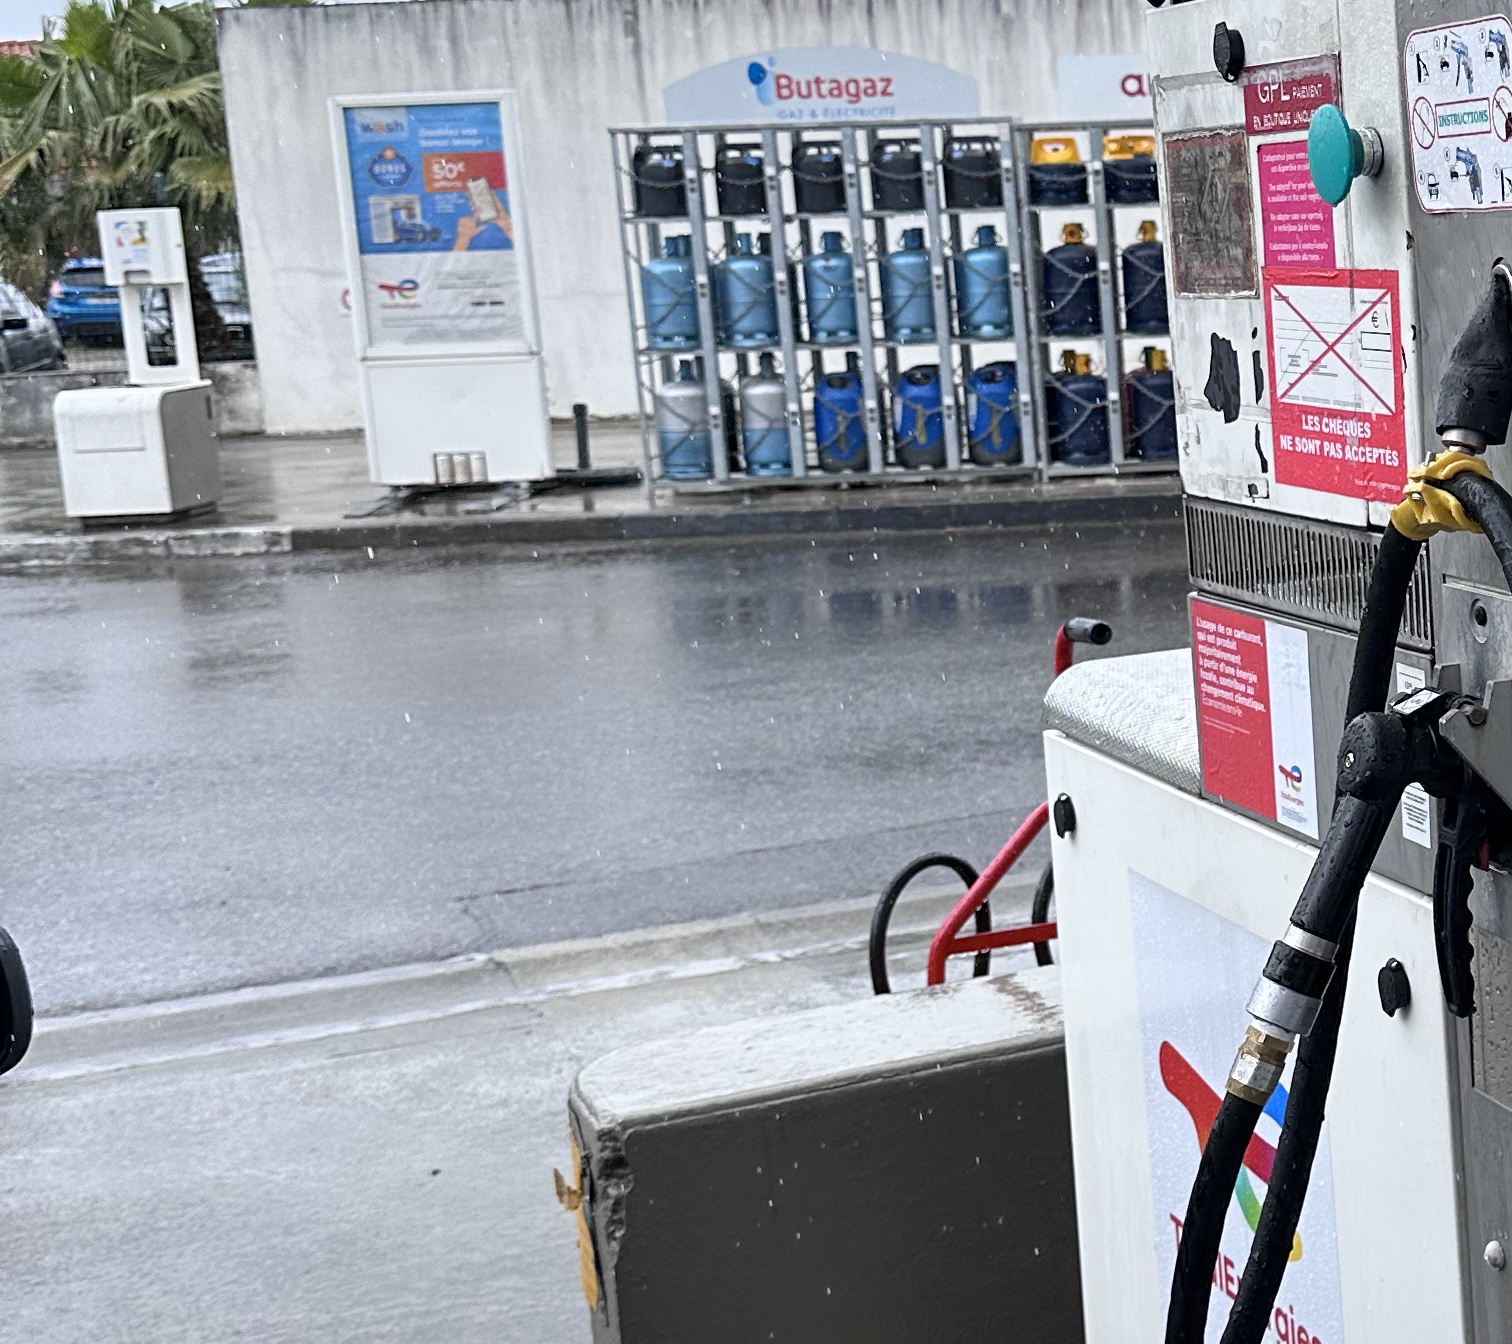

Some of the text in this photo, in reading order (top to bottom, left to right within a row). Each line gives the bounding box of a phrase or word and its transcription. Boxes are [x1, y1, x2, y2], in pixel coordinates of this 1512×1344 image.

[774, 74, 894, 104] Butagaz
[1257, 68, 1291, 104] GPL
[1438, 109, 1489, 128] INSTRUCTIONS
[1371, 310, 1380, 329] €
[1301, 414, 1372, 439] LES CHÈQUES
[1279, 434, 1399, 468] NE SONT PAS ACCEPTÉS
